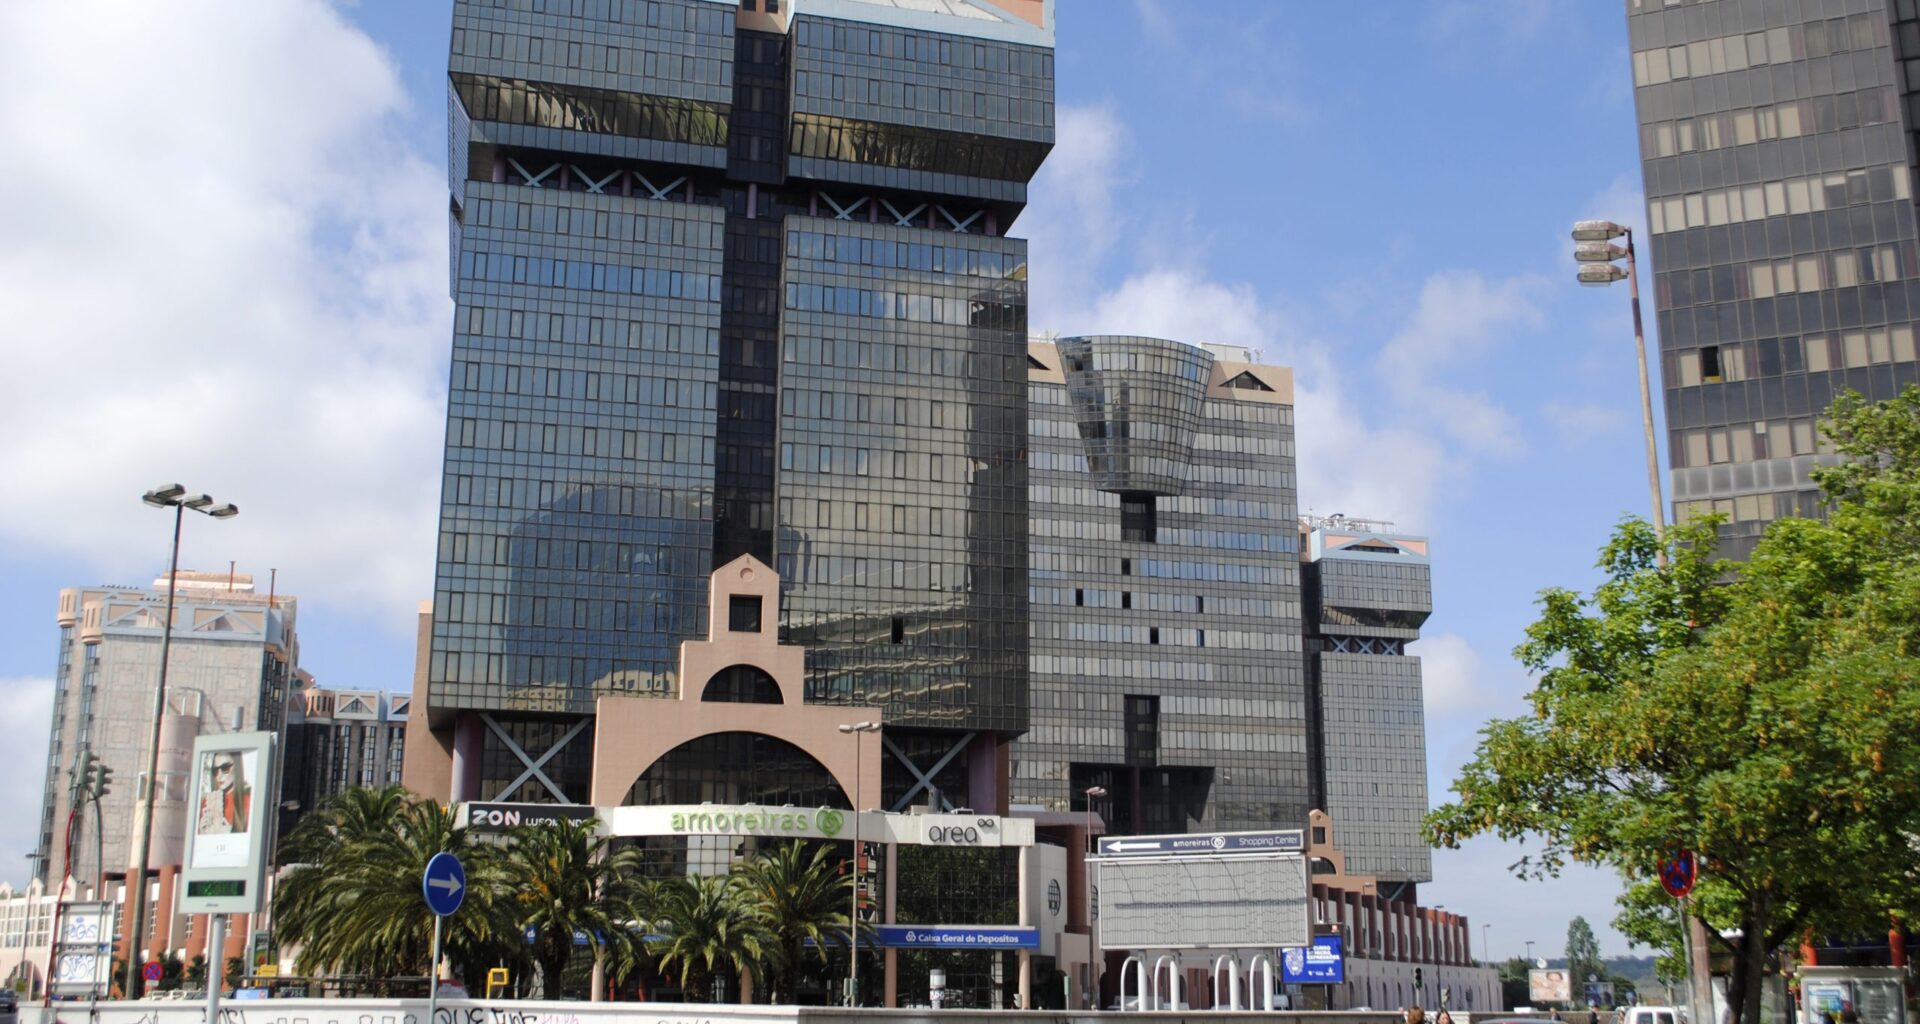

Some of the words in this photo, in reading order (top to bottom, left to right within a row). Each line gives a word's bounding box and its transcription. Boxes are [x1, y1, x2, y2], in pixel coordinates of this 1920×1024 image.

[472, 809, 520, 826] ZON
[671, 808, 808, 834] amoreiras
[928, 825, 978, 843] area
[1173, 839, 1210, 848] amoreiras
[1239, 836, 1274, 847] Shopping
[1275, 836, 1298, 845] Center
[918, 934, 940, 943] Caixa
[942, 934, 964, 943] Geral
[965, 935, 976, 943] de
[977, 934, 1019, 944] Depositos
